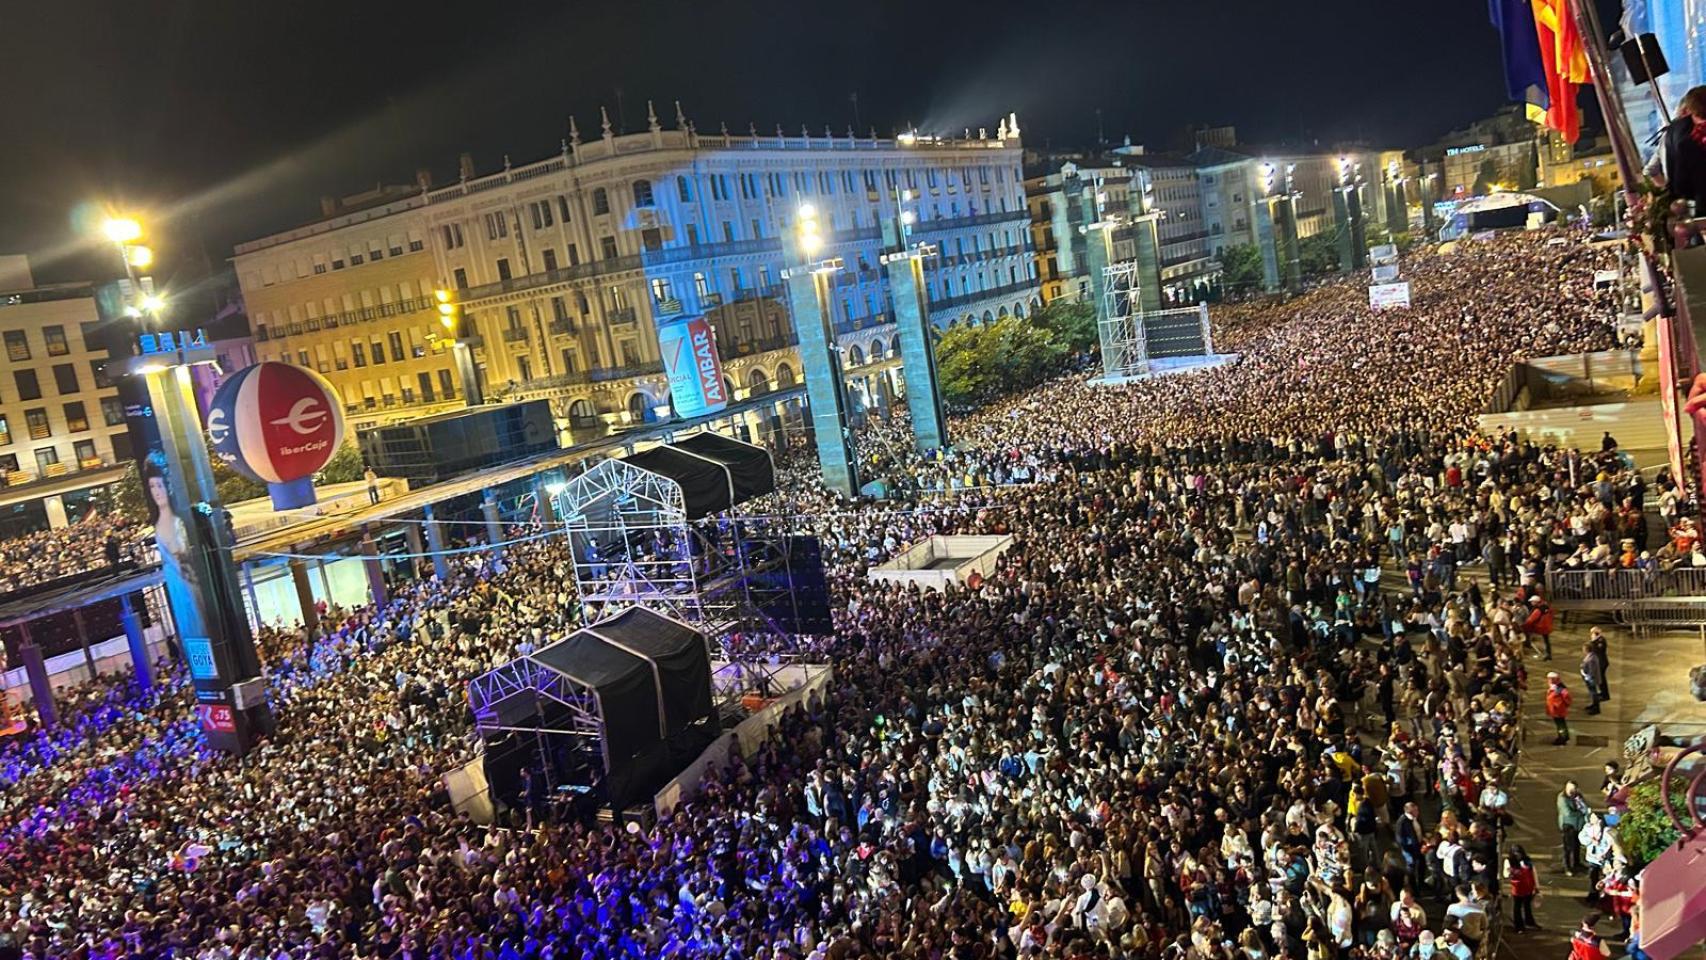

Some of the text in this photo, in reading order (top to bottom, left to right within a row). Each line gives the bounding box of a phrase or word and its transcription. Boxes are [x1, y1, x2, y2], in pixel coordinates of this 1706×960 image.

[1460, 144, 1485, 153] HOTELS
[693, 329, 722, 400] AMBAR
[192, 655, 213, 666] GOYA
